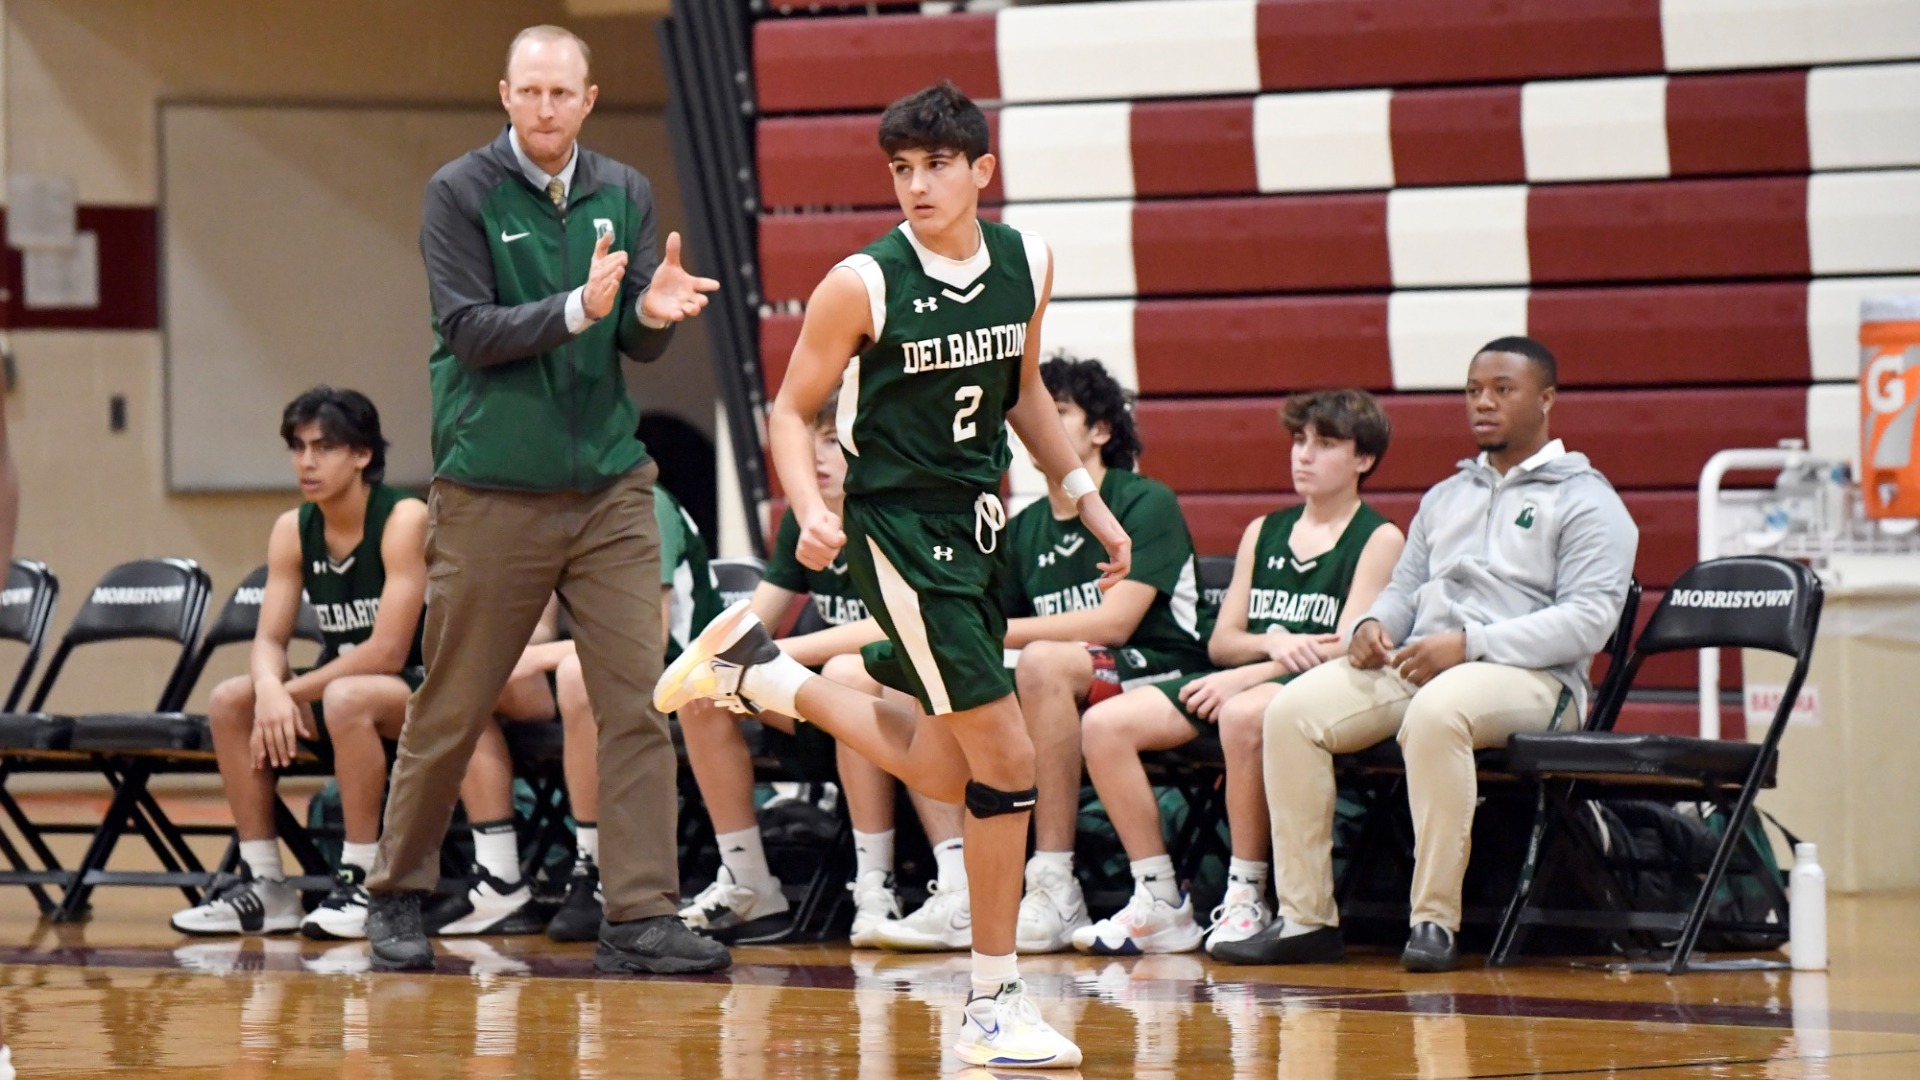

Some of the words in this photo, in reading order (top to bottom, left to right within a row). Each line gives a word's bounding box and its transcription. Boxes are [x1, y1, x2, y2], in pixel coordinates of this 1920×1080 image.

[901, 322, 1027, 374] DELBARTON
[1866, 354, 1906, 414] G
[952, 385, 984, 443] 2
[91, 584, 186, 605] MORRISTOWN
[1670, 588, 1795, 608] MORRISTOWN
